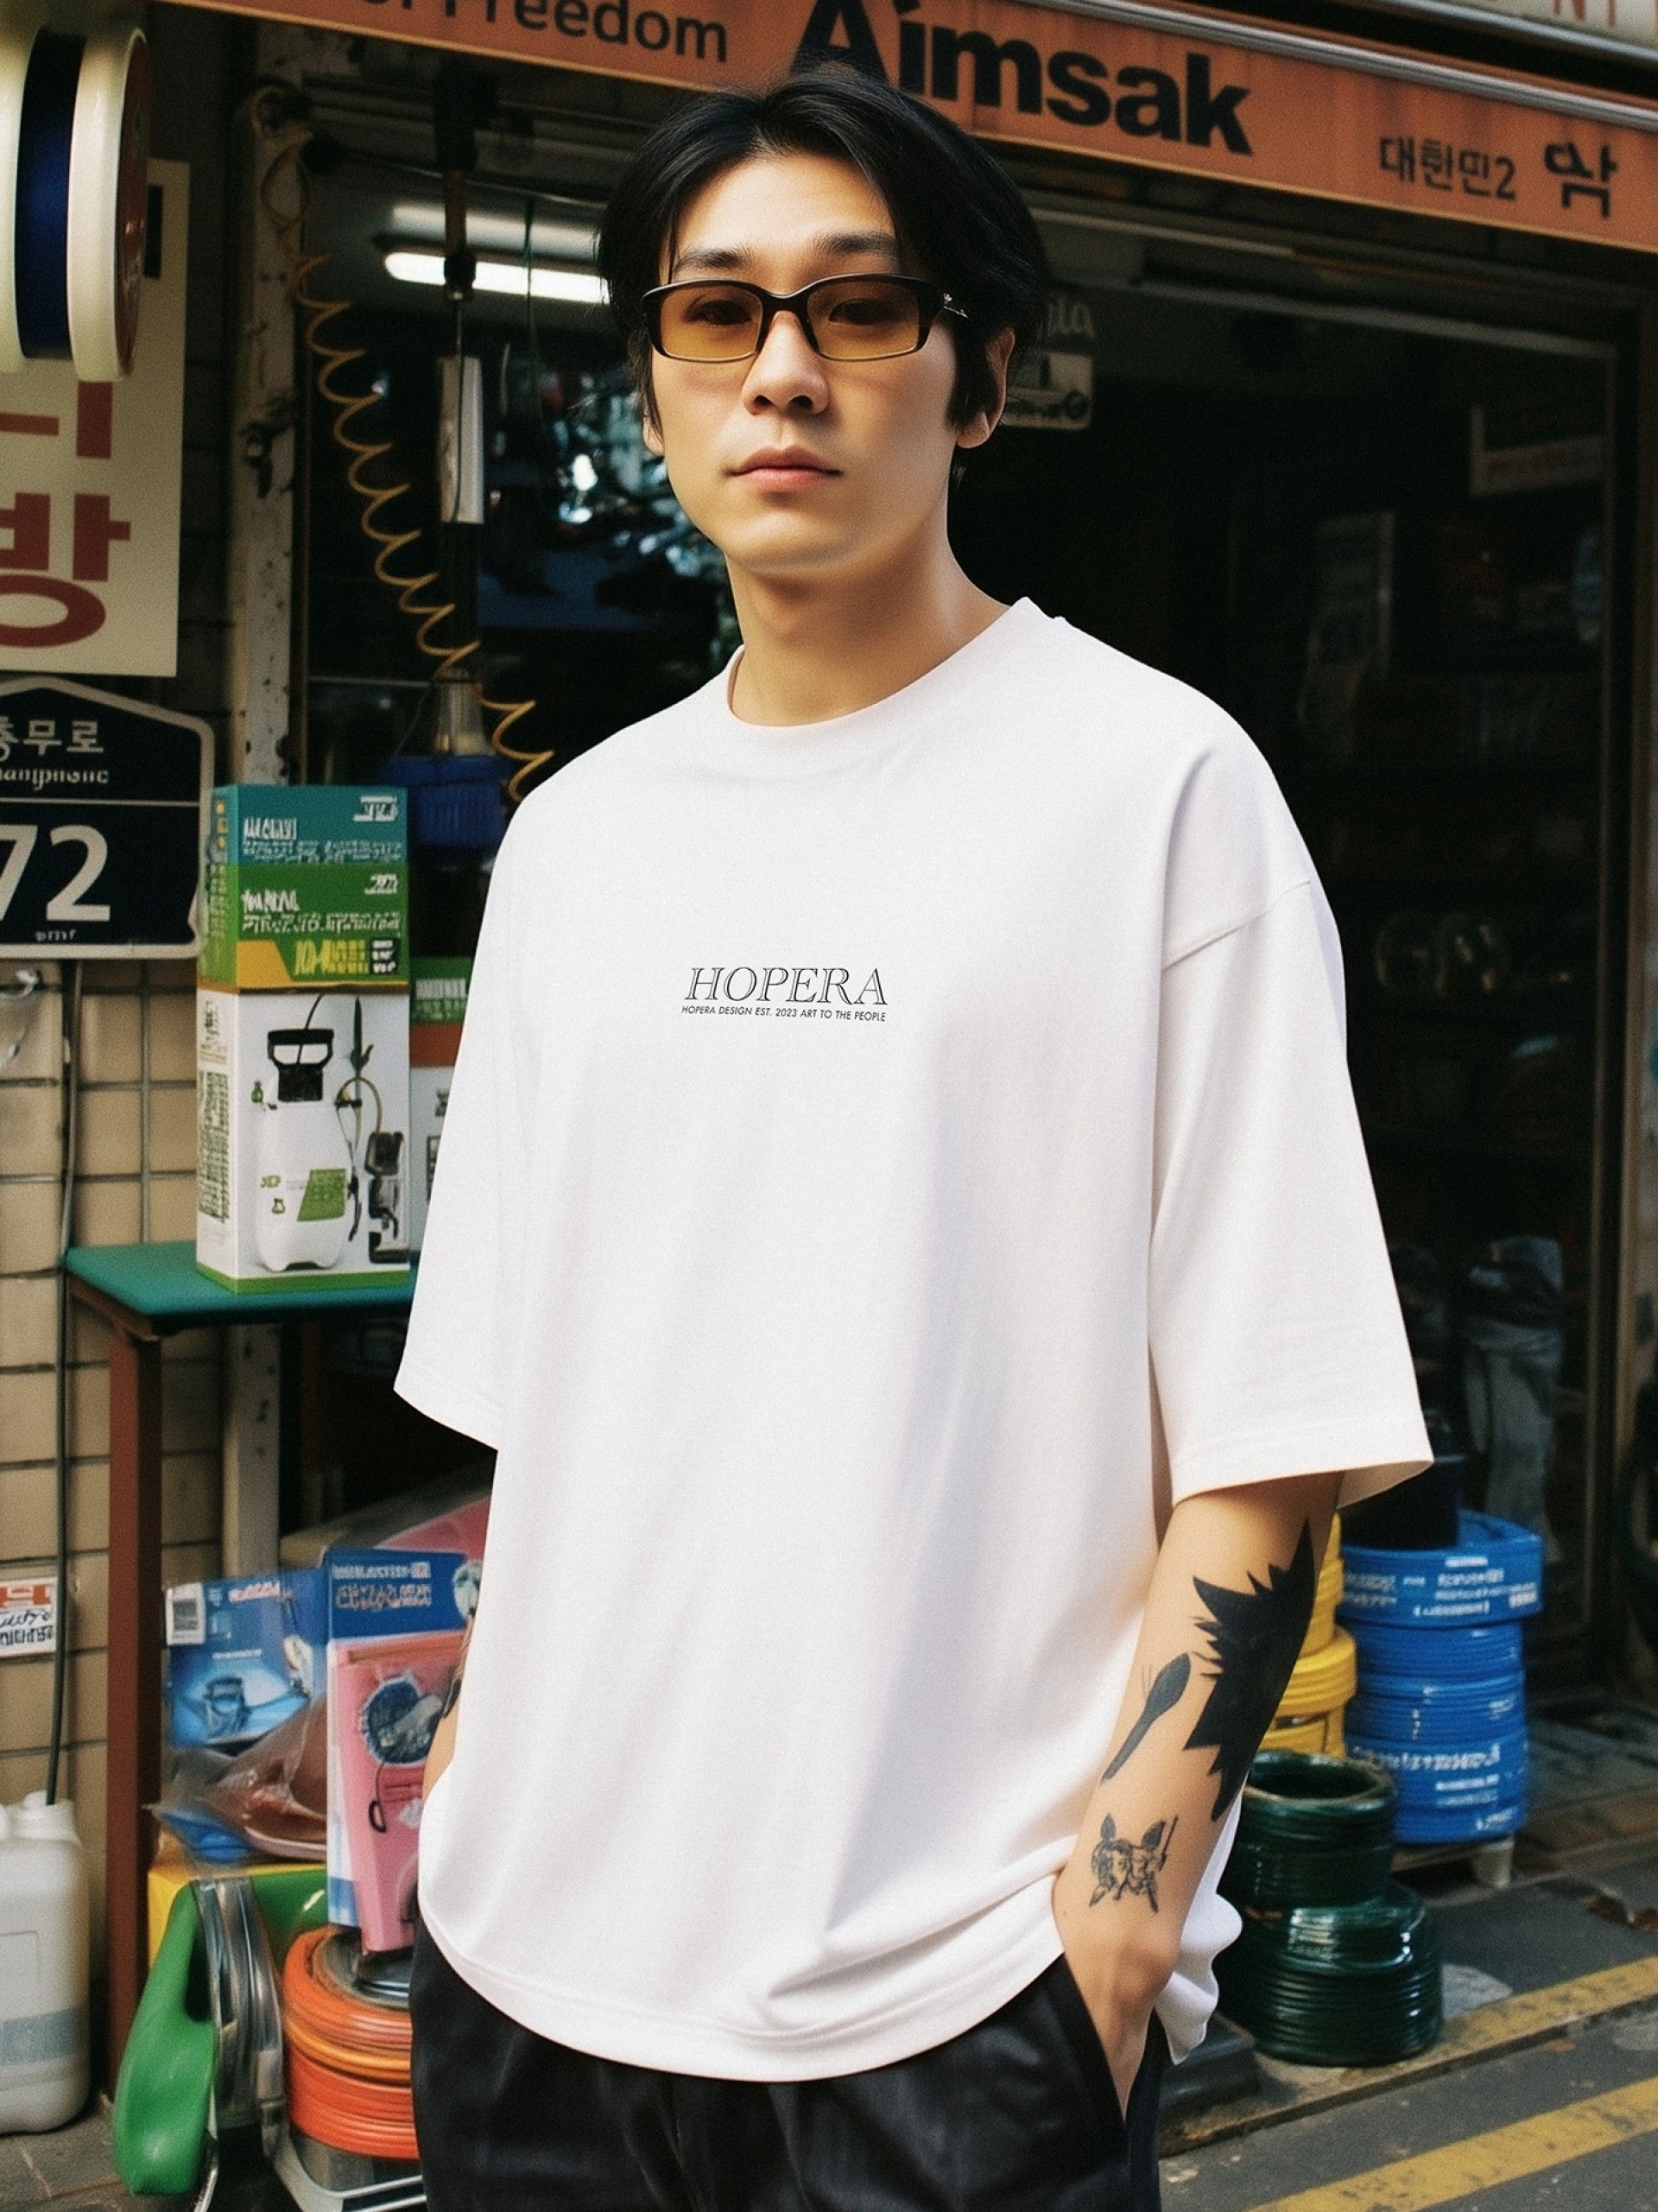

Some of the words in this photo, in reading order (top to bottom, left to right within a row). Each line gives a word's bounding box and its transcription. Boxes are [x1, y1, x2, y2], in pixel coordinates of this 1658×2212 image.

[787, 0, 1254, 157] Aimsak
[0, 825, 111, 922] 72
[681, 1005, 716, 1015] HOPERA
[718, 1006, 753, 1016] DESIGN
[775, 1008, 797, 1017] 2023
[820, 1010, 832, 1019] TO
[835, 1011, 851, 1020] THE
[854, 1011, 886, 1021] PEOPLE
[684, 966, 889, 1005] HOPERA
